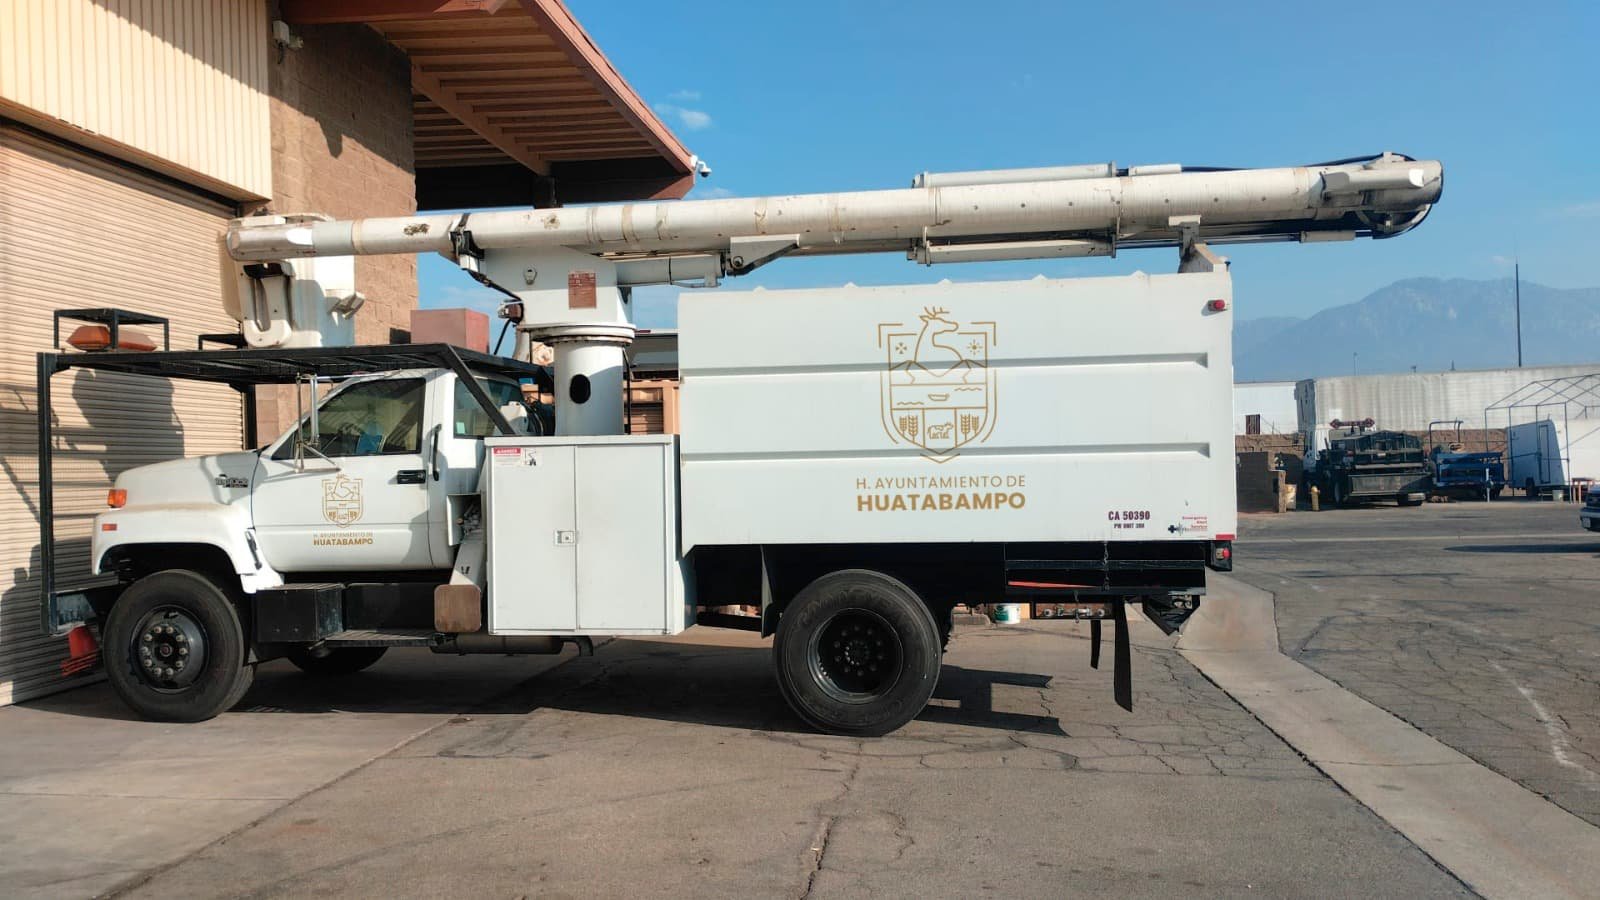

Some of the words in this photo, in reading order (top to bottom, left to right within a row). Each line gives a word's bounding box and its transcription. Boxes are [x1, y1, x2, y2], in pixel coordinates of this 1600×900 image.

[856, 477, 871, 490] H.
[875, 475, 1002, 489] AYUNTAMIENTO
[1006, 475, 1026, 487] DE
[857, 492, 1026, 511] HUATABAMPO
[1108, 511, 1120, 521] CA
[1122, 511, 1150, 520] 50390
